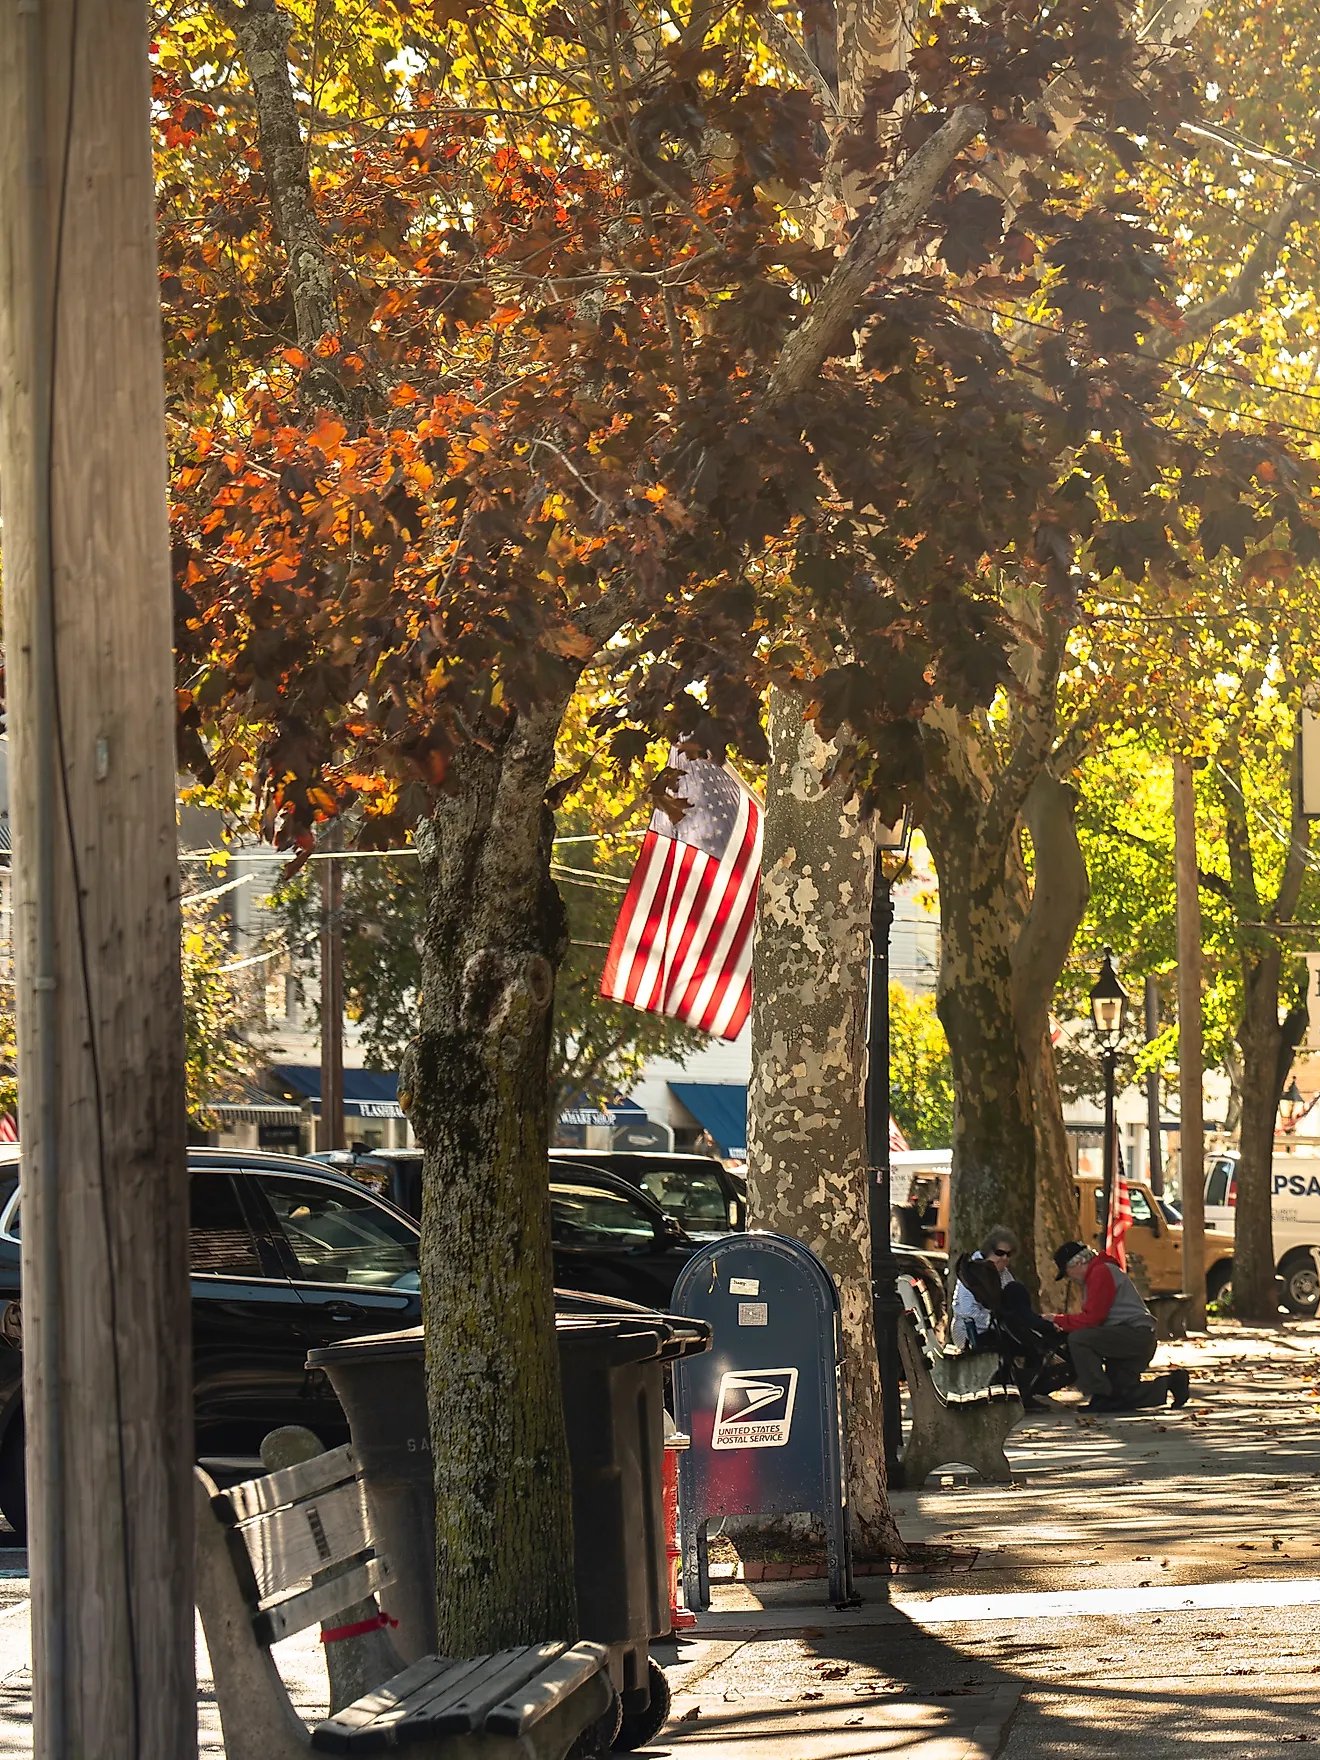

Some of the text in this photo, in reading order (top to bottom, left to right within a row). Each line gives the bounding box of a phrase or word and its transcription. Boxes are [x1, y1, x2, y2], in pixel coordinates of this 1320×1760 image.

[719, 1424, 780, 1436] UNITED STATES
[717, 1433, 783, 1444] POSTAL SERVICE
[407, 1438, 430, 1452] SA
